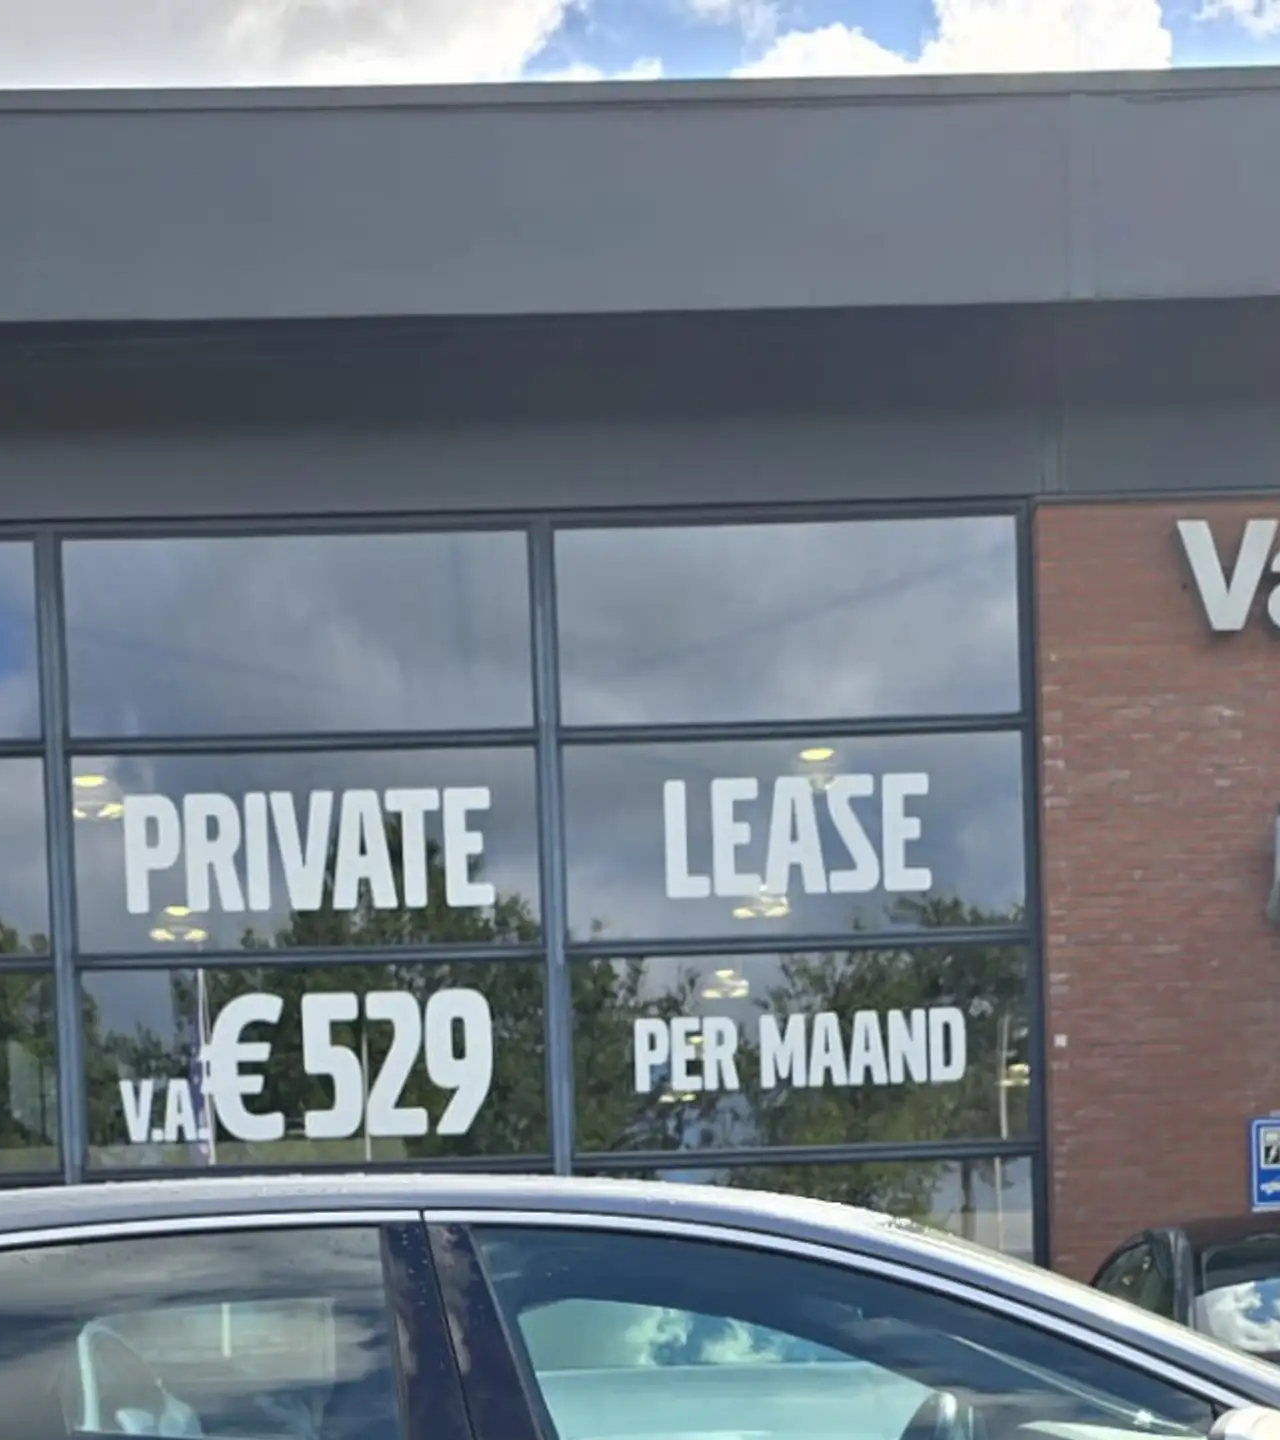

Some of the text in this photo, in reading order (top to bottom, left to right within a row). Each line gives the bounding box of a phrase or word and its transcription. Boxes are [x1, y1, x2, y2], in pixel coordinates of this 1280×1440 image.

[122, 786, 495, 915] PRIVATE
[662, 772, 933, 900] LEASE
[633, 1015, 740, 1094] PER
[758, 1006, 968, 1090] MAAND
